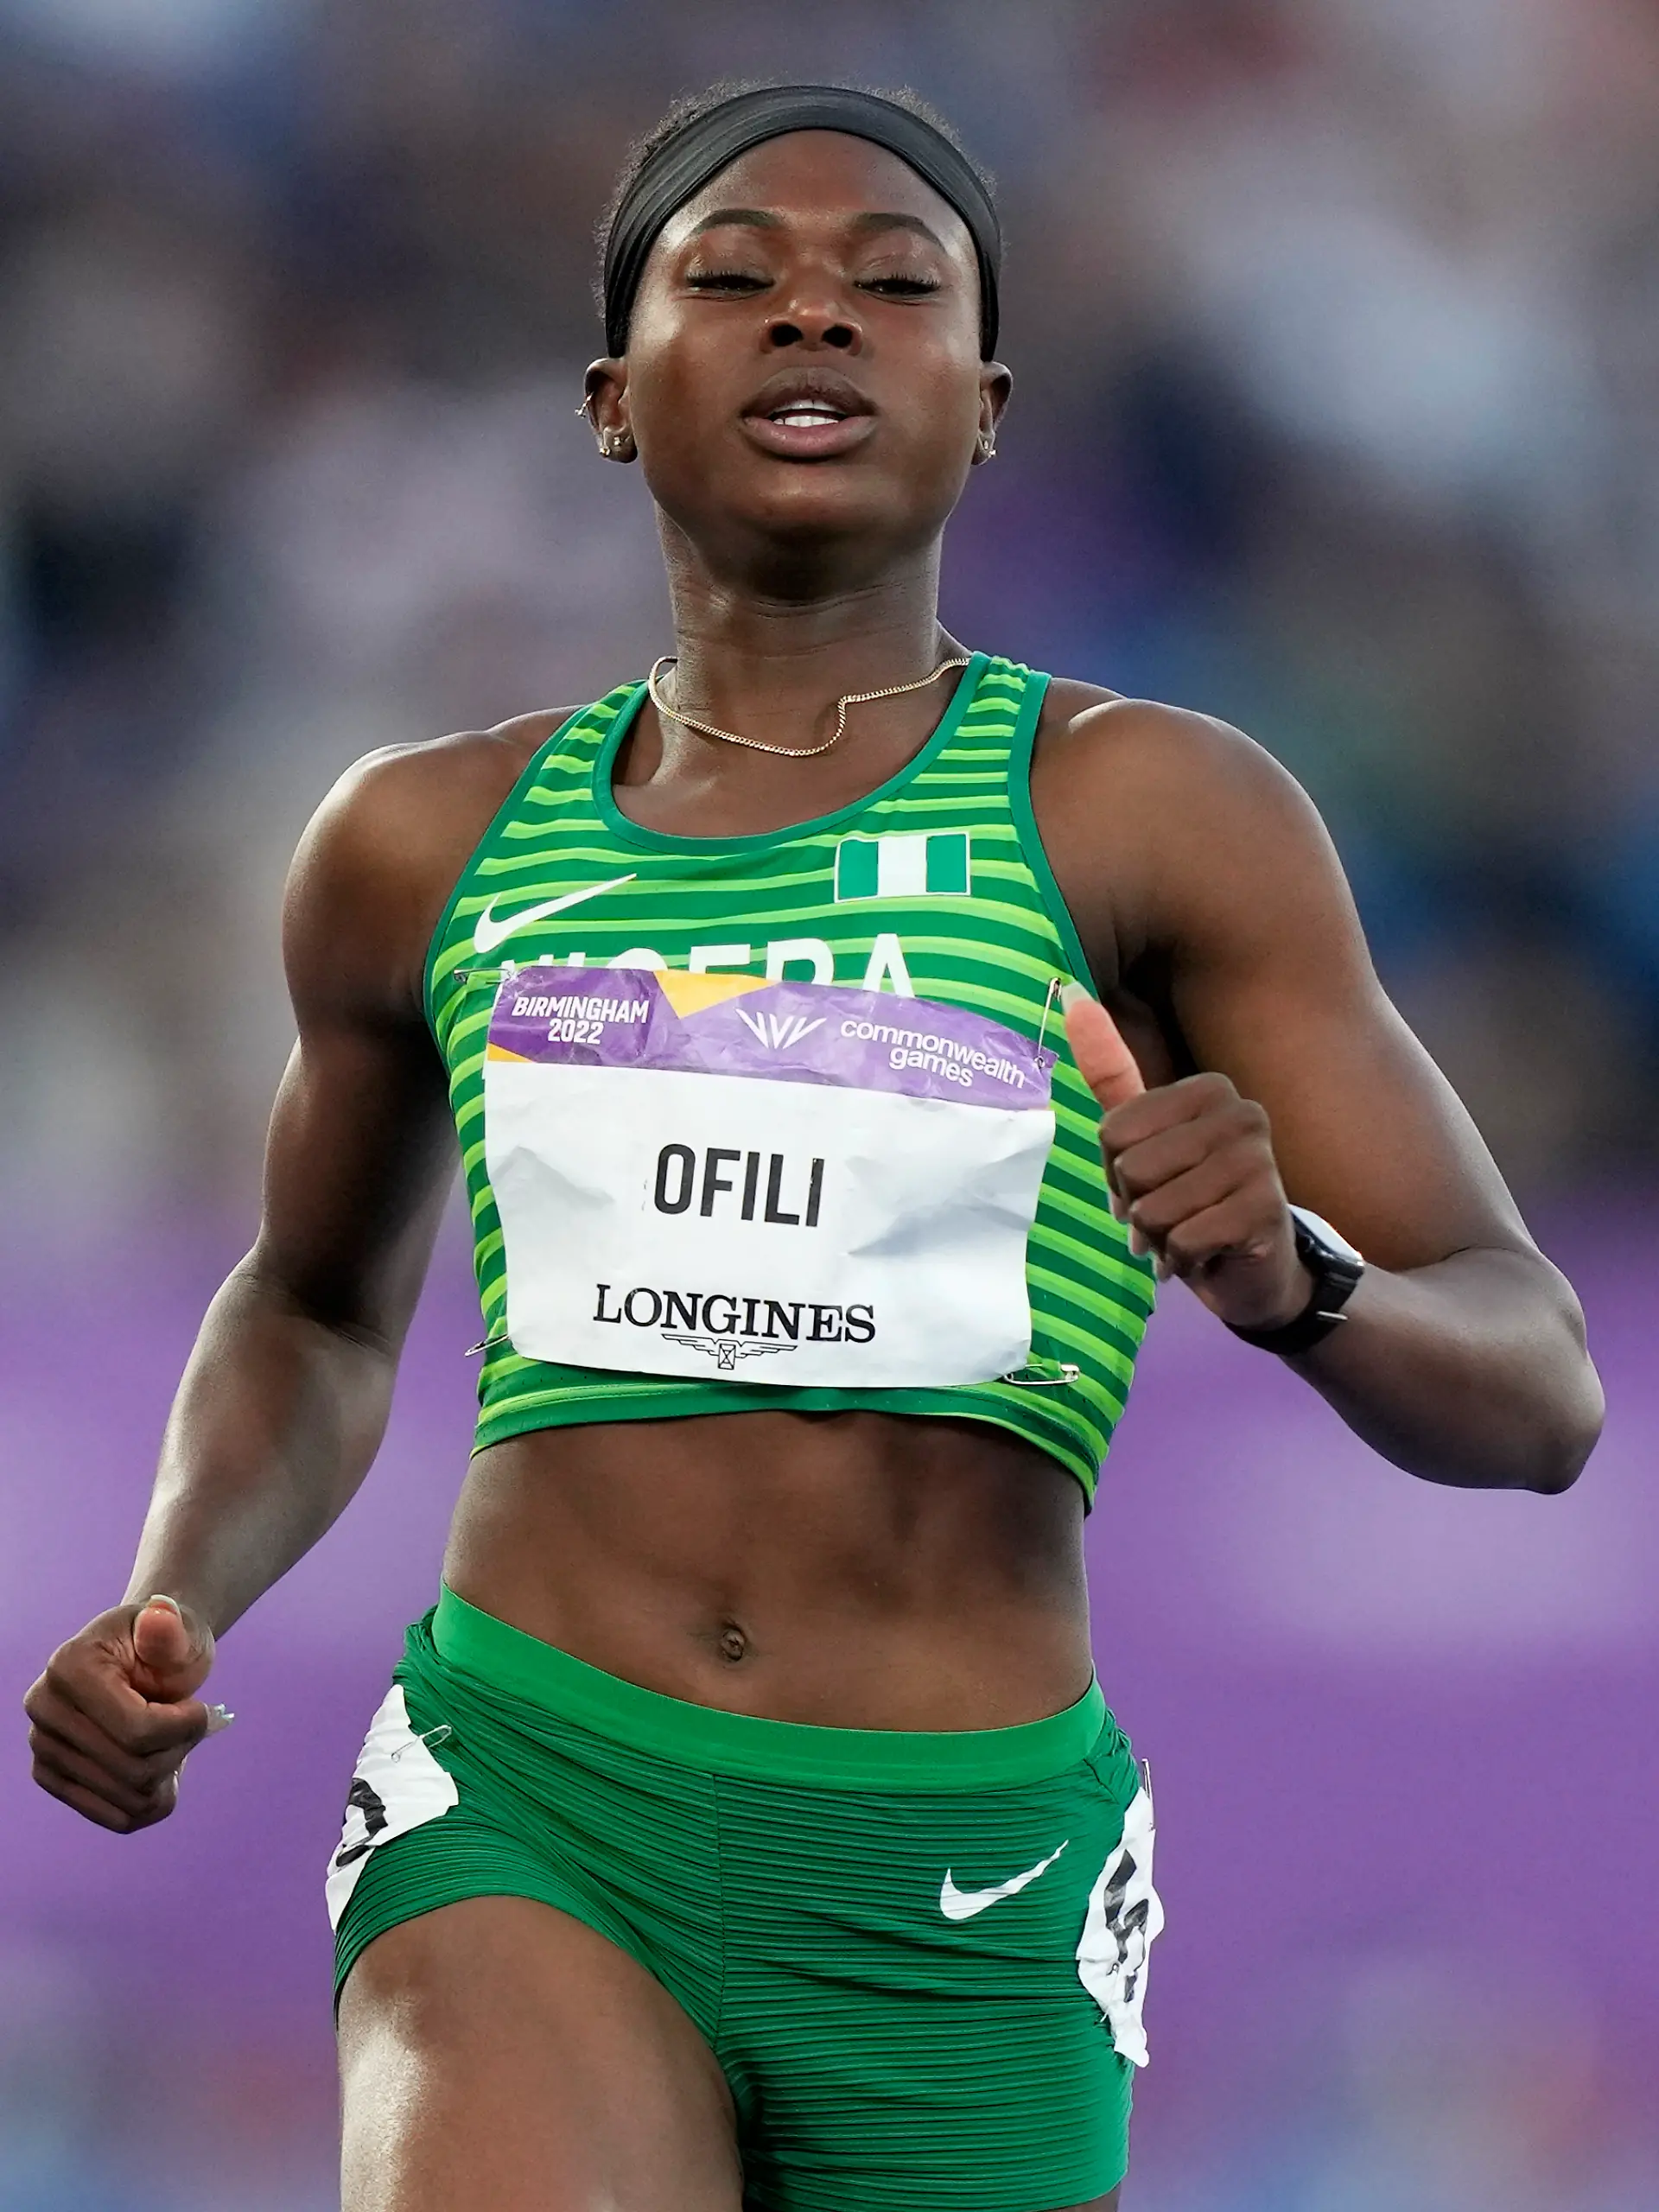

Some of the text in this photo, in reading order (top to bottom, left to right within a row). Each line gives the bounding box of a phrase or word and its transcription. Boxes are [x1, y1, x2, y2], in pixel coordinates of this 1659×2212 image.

[512, 995, 650, 1024] BIRMINGHAM
[547, 1018, 604, 1045] 2022
[840, 1020, 1027, 1089] commonwealth
[888, 1046, 974, 1087] games
[654, 1143, 824, 1227] OFILI
[593, 1283, 876, 1343] LONGINES
